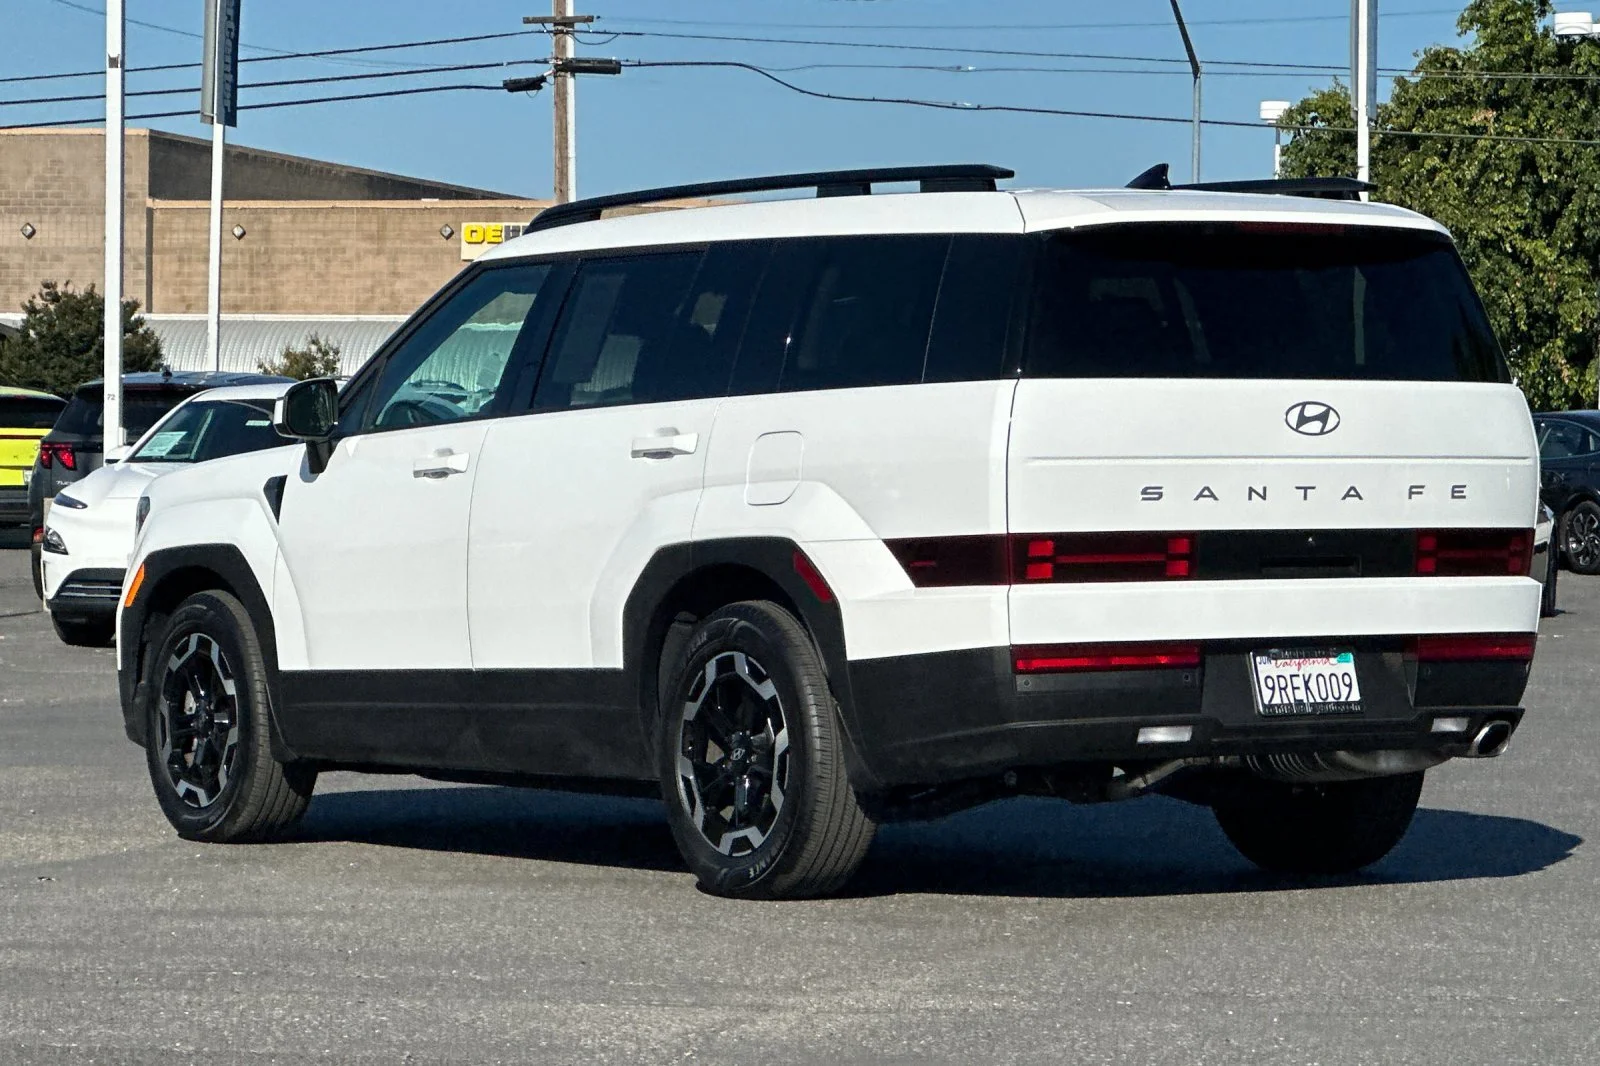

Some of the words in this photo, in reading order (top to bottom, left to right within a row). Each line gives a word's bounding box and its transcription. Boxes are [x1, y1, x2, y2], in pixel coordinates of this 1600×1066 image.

[107, 393, 116, 401] 72
[1140, 486, 1364, 501] SANTA
[1408, 485, 1468, 500] FE
[1264, 672, 1353, 704] 9REK009
